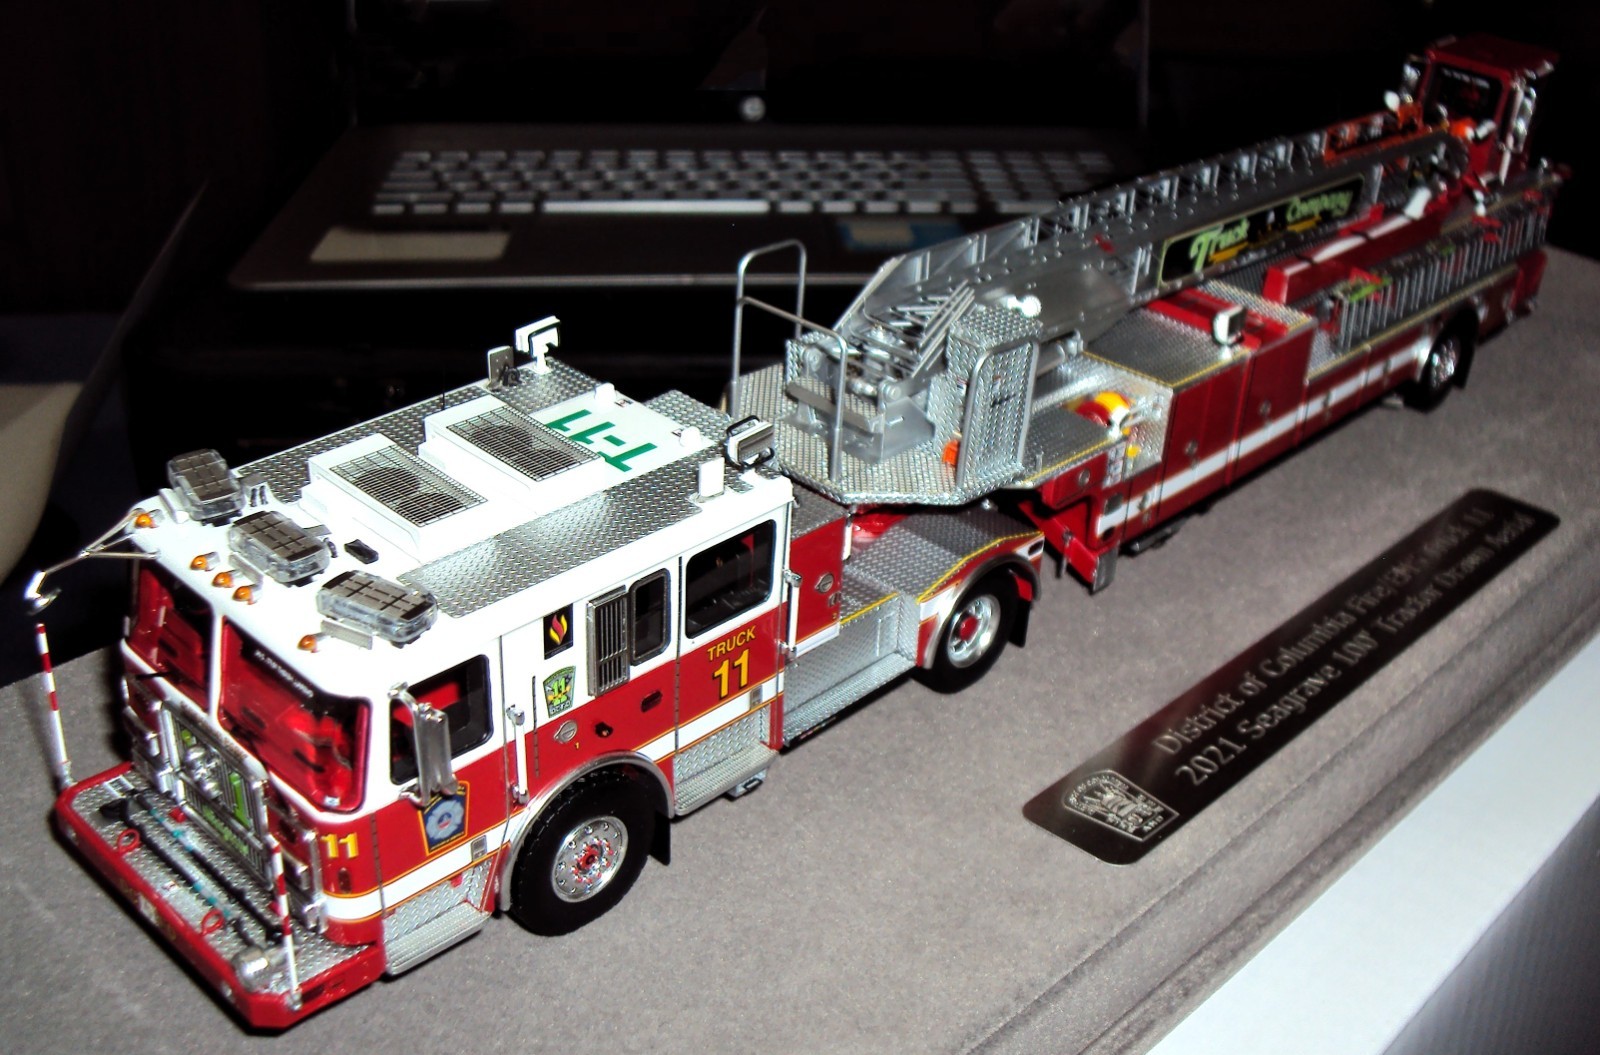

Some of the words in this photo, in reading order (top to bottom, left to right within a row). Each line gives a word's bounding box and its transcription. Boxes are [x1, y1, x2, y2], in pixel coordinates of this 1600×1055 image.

[544, 409, 658, 472] T-11
[707, 625, 756, 661] TRUCK
[712, 648, 749, 699] 11
[1152, 692, 1245, 755] District
[1238, 671, 1268, 697] of
[1260, 611, 1357, 677] Columbia
[1175, 736, 1248, 786] 2021
[1237, 665, 1342, 739] Seagrave
[1375, 583, 1443, 634] Tractor
[320, 831, 359, 859] 11
